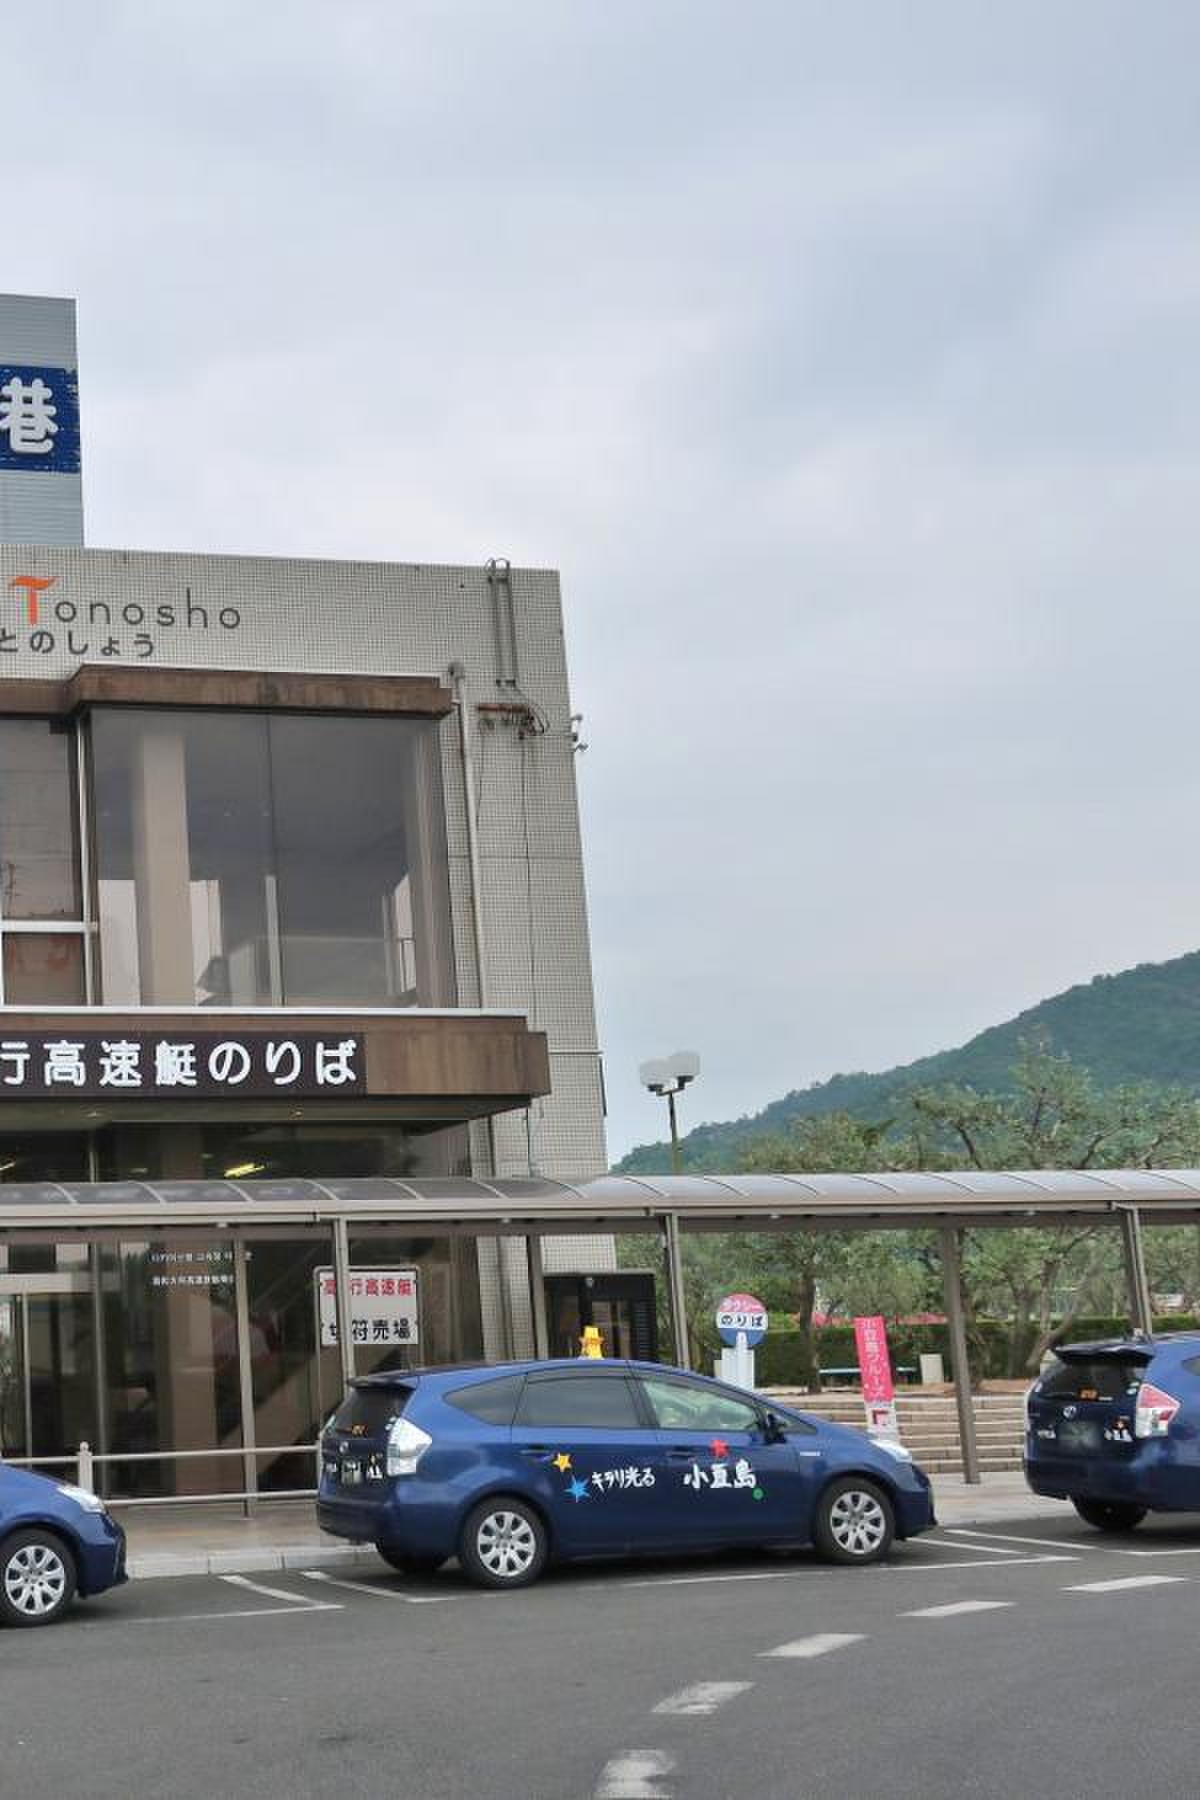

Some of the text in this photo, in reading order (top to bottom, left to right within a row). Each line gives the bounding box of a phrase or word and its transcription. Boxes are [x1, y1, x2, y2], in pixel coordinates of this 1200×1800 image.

[7, 574, 241, 630] Tonosho
[721, 1314, 763, 1327] のりば
[591, 1458, 757, 1494] キラリ光る 小豆島
